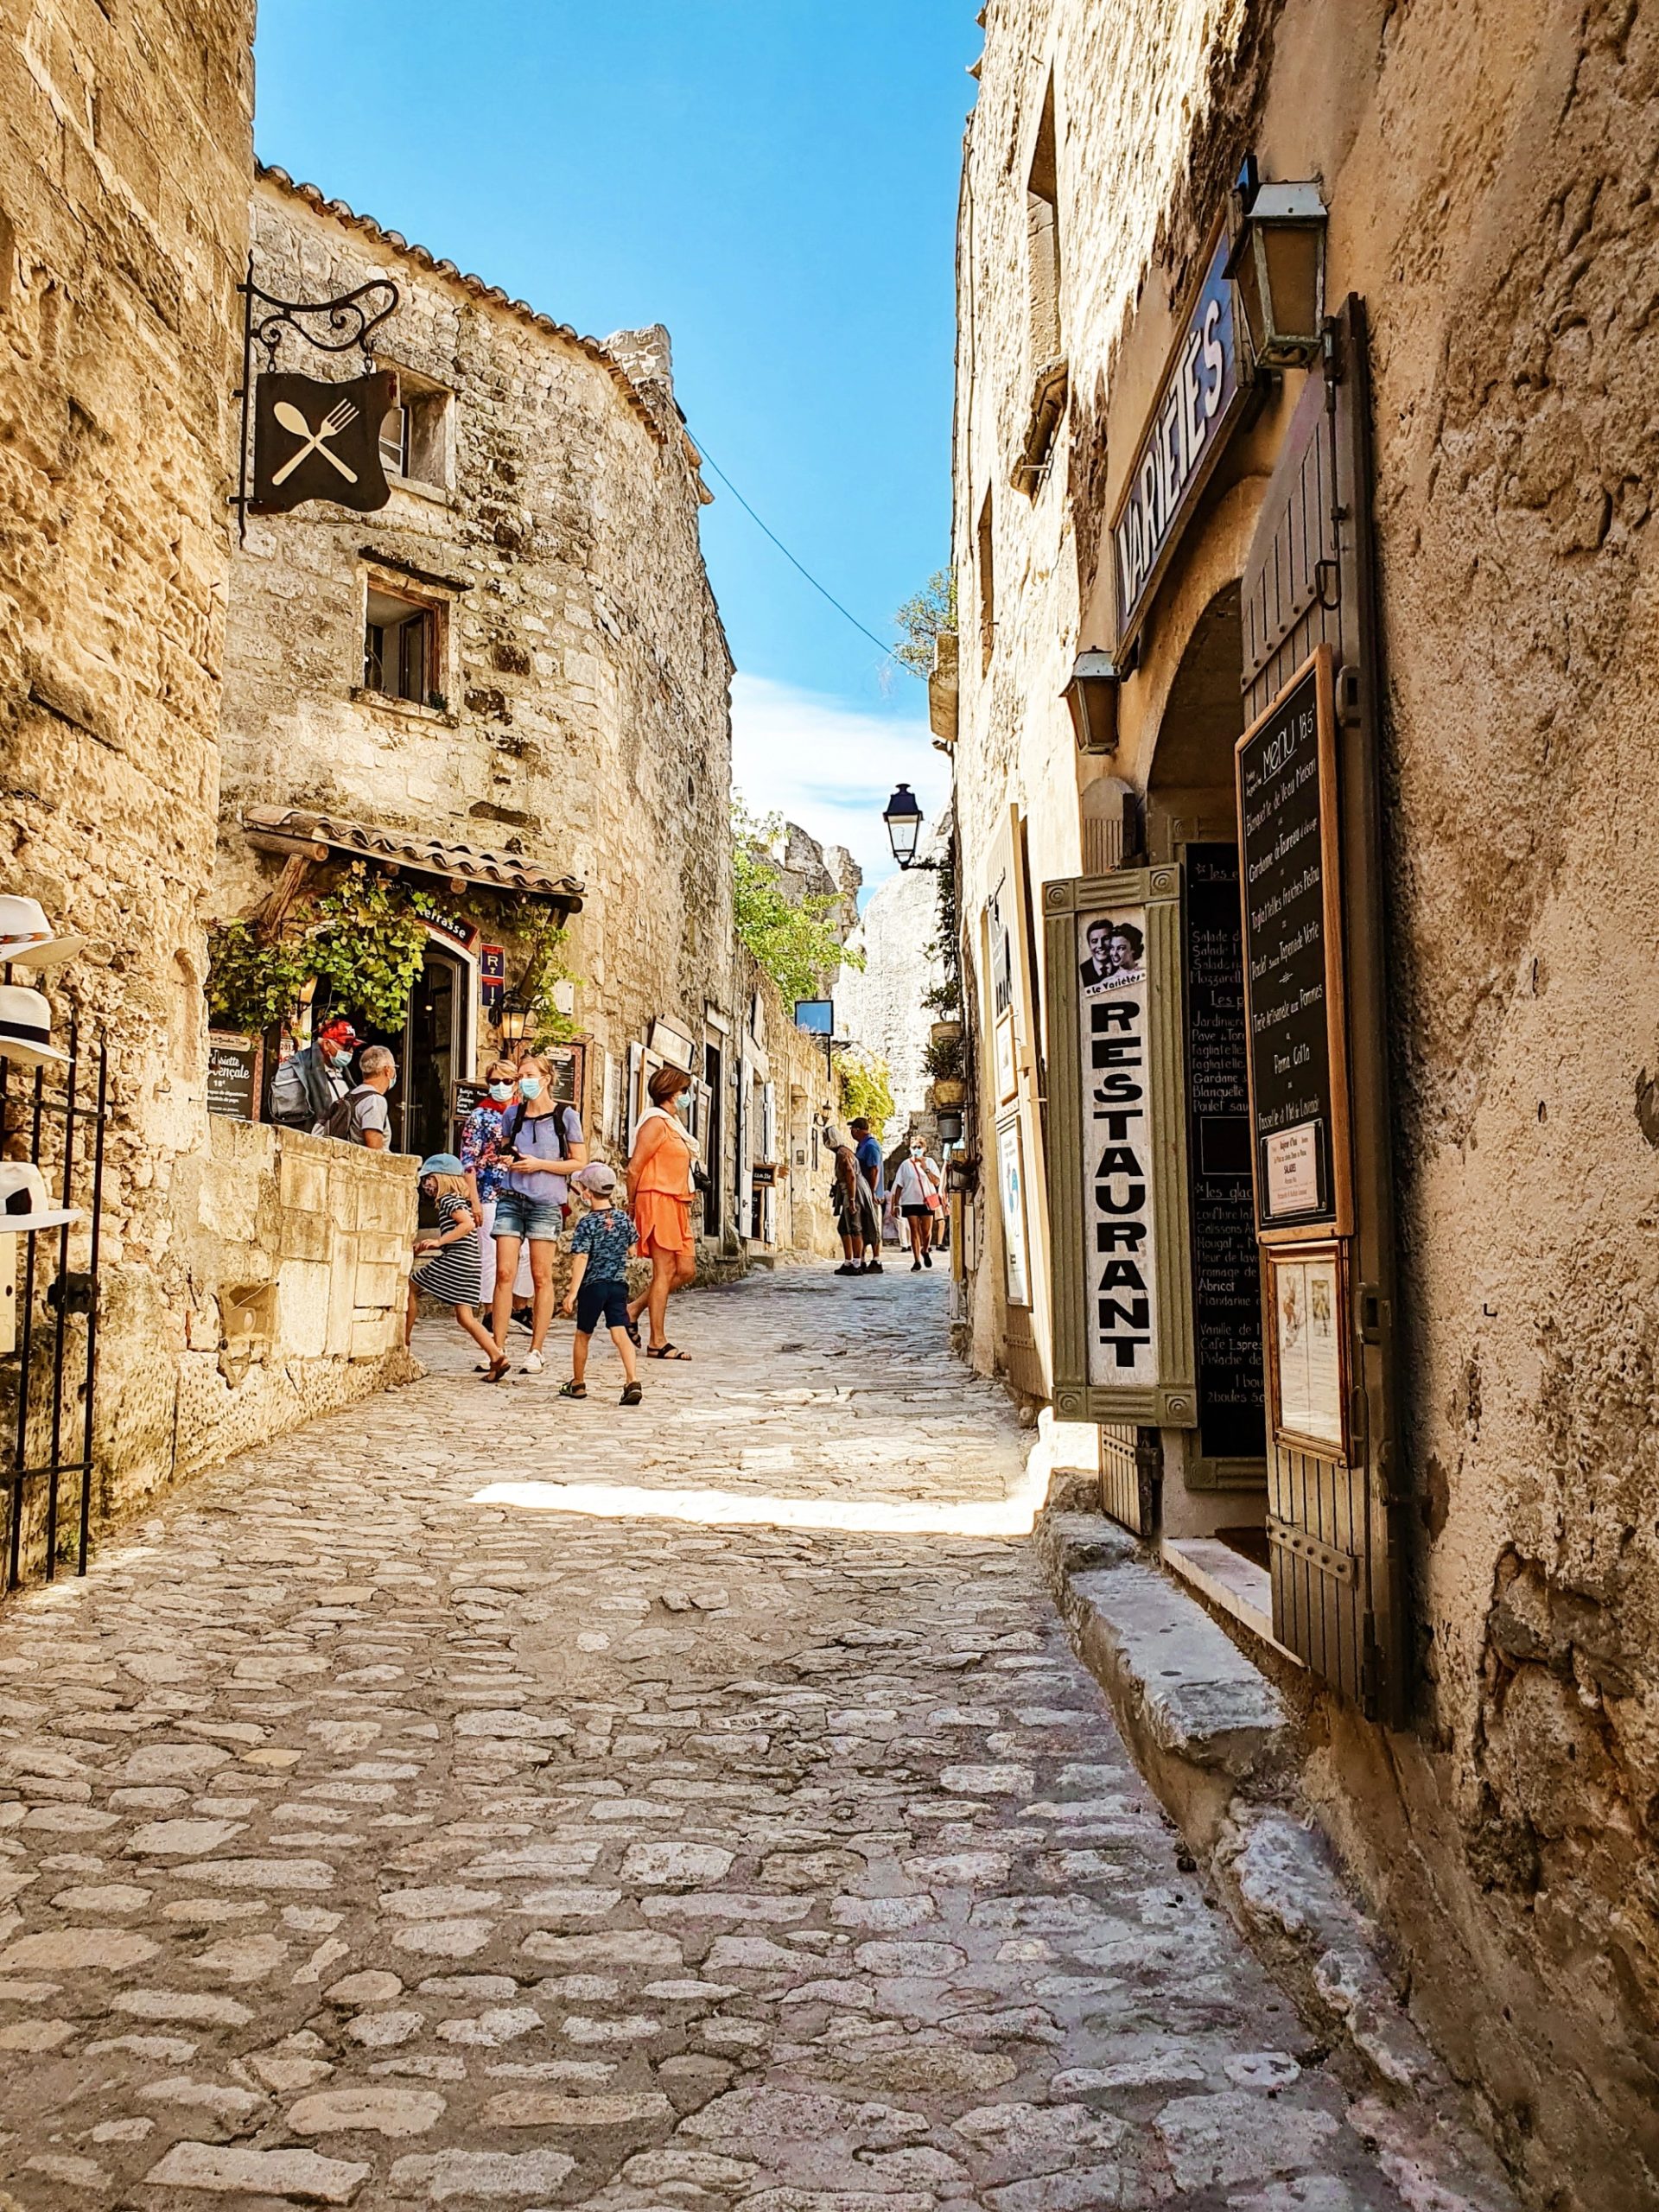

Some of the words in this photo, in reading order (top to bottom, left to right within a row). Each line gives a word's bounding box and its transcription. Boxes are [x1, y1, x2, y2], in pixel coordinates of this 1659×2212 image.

[1210, 863, 1227, 880] les
[1192, 929, 1228, 944] Salade
[1192, 943, 1228, 958] Salade
[1211, 990, 1232, 1006] Les
[1193, 1099, 1225, 1113] Poulet
[1090, 1000, 1151, 1369] RESTAURANT
[1205, 1181, 1223, 1198] les
[1197, 1236, 1233, 1251] Nougat
[1224, 1250, 1237, 1263] de
[1244, 1265, 1257, 1278] de
[1198, 1277, 1235, 1293] Abricot
[1198, 1293, 1251, 1306] Mandarine
[1200, 1321, 1232, 1336] Vanille
[1238, 1322, 1252, 1336] de
[1249, 1351, 1262, 1366] de
